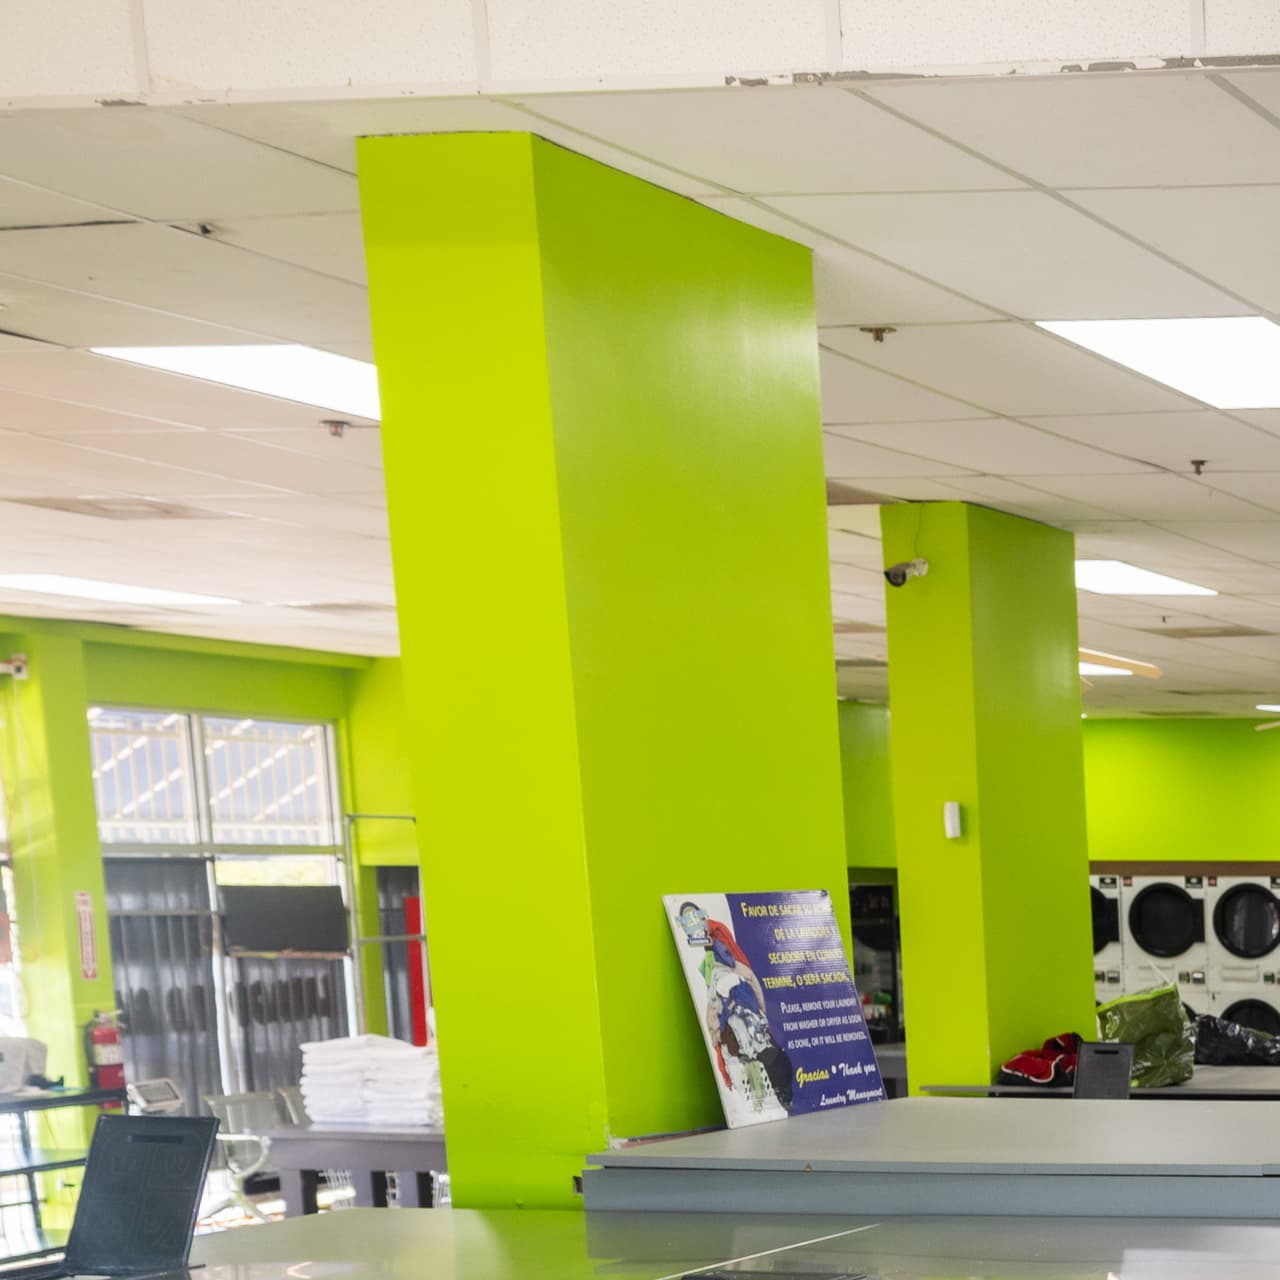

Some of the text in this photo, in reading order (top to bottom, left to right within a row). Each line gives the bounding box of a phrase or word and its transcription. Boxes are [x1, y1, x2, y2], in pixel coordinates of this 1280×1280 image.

[796, 1062, 876, 1088] Gracias Thank you
[820, 1094, 846, 1106] Laundry
